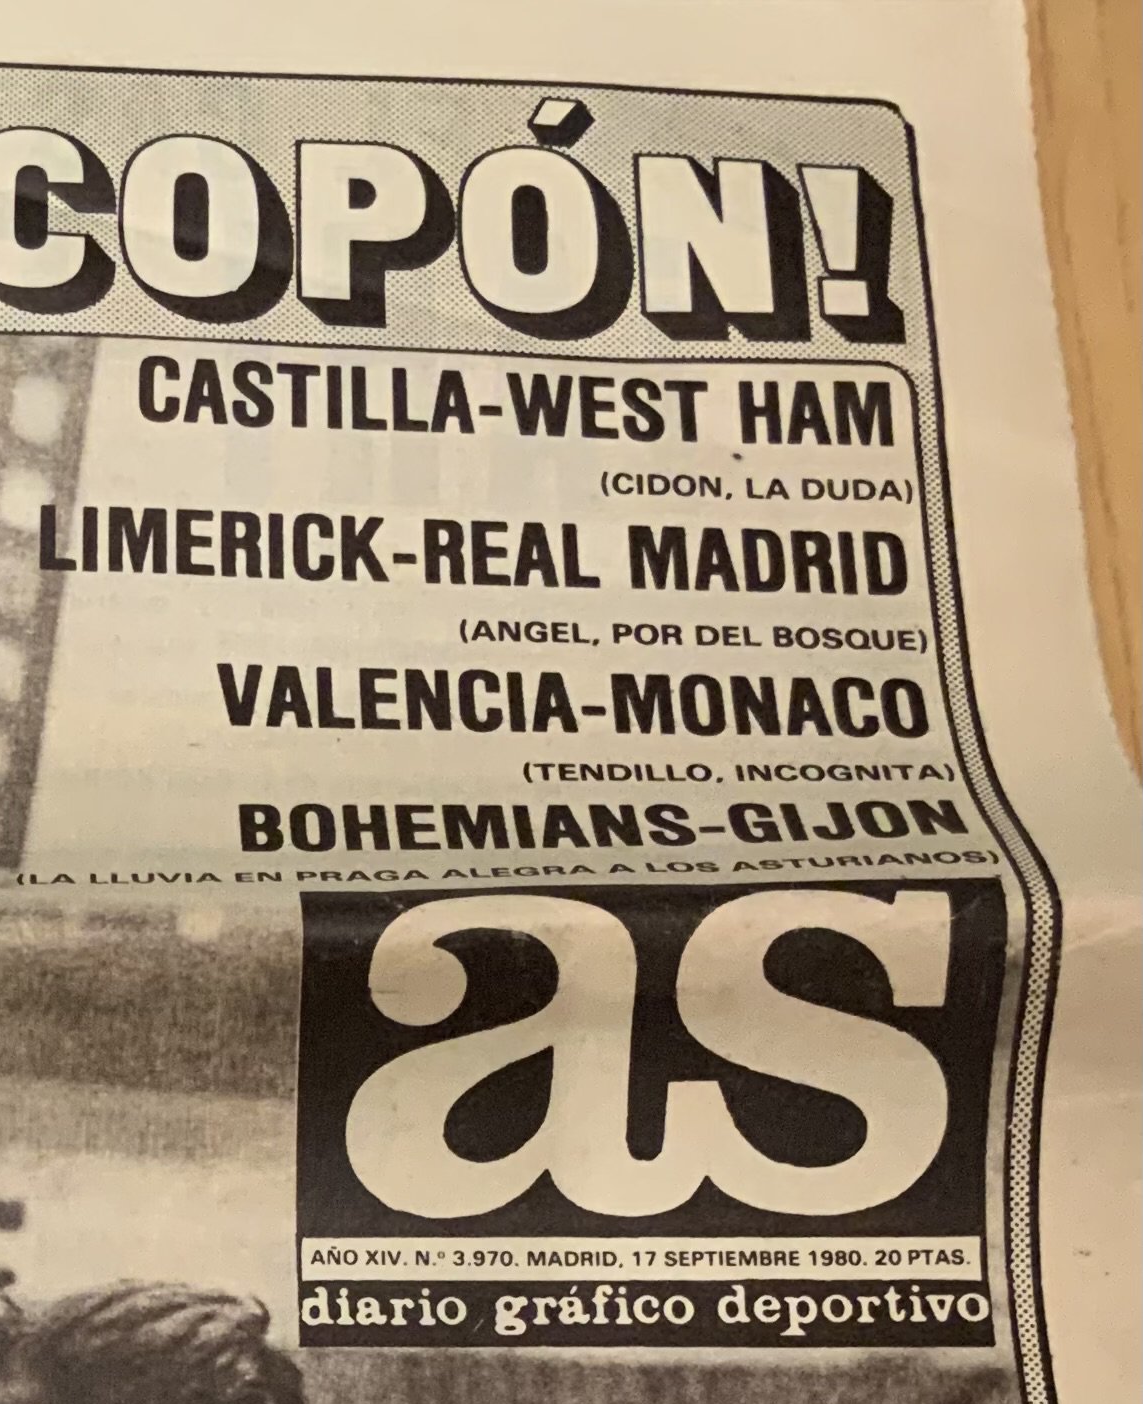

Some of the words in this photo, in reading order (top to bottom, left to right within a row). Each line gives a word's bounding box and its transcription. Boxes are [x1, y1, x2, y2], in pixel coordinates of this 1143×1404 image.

[138, 354, 708, 445] CASTILLA-WEST
[740, 380, 894, 446] HAM
[600, 470, 734, 502] (CIDON,
[746, 474, 794, 500] LA
[804, 475, 914, 505] DUDA)
[39, 503, 600, 588] LIMERICK-REAL
[628, 525, 908, 597] MADRID
[459, 618, 602, 650] (ANGEL,
[613, 622, 684, 647] POR
[698, 625, 762, 647] DEL
[774, 624, 928, 654] BOSQUE)
[216, 662, 930, 738] VALENCIA-MONACO
[522, 760, 726, 786] (TENDILLO,
[736, 760, 955, 784] INCOGNITA)
[238, 798, 970, 856] BOHEMIANS-GIJON
[16, 872, 76, 886] (LA
[89, 871, 222, 885] LLUVIA
[235, 870, 283, 883] EN
[296, 868, 431, 882] PRAGA
[441, 865, 596, 880] ALEGRA
[608, 862, 636, 874] A
[645, 859, 721, 874] LOS
[731, 848, 1001, 873] ASTURIANOS)
[345, 889, 953, 1220] as
[310, 1246, 358, 1267] AÑO
[365, 1250, 408, 1267] XIV.
[452, 1249, 519, 1267] 3.970.
[526, 1249, 624, 1269] MADRID,
[632, 1249, 656, 1267] 17
[664, 1250, 800, 1267] SEPTIEMBRE
[808, 1249, 867, 1267] 1980.
[874, 1250, 901, 1267] 20
[908, 1249, 971, 1267] PTAS.
[301, 1285, 467, 1326] diario
[494, 1284, 695, 1336] gráfico
[717, 1285, 990, 1336] deportivo
